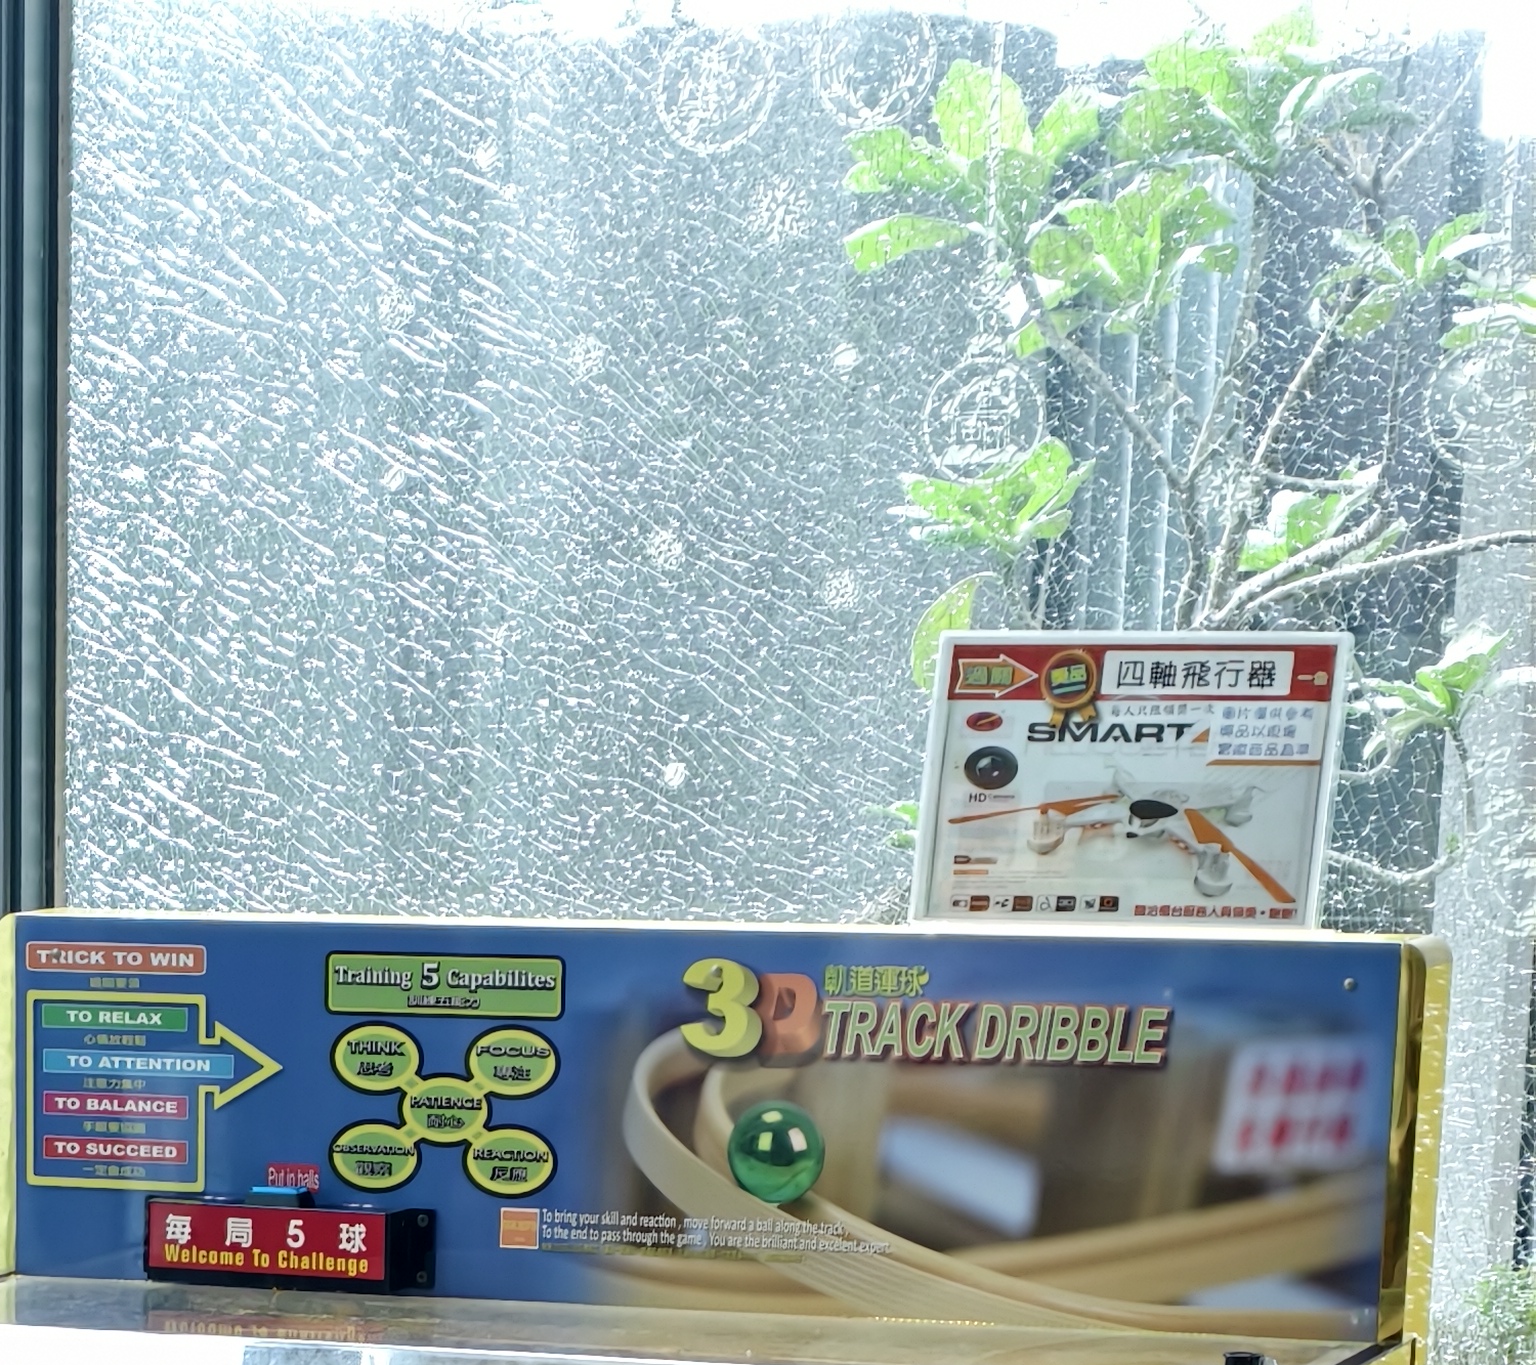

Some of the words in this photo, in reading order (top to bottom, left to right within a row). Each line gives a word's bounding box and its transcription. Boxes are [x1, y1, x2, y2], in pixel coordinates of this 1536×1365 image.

[1116, 660, 1276, 689] 四軸飛行器
[1027, 722, 1197, 744] SMART
[969, 793, 987, 803] HD
[37, 949, 106, 966] TRICK
[112, 951, 143, 966] TO
[150, 951, 195, 968] WIN
[335, 965, 412, 990] Training
[421, 962, 440, 988] 5
[447, 968, 556, 993] Capabilites
[66, 1010, 92, 1023] TO
[98, 1011, 163, 1025] RELAX
[680, 957, 819, 1062] 3D
[823, 1000, 970, 1060] TRACK
[975, 1004, 1170, 1065] DRIBBLE
[348, 1040, 406, 1055] THINK
[476, 1046, 551, 1057] FOCUS
[67, 1055, 92, 1067] TO
[98, 1057, 210, 1071] ATTENTION
[54, 1097, 81, 1110] TO
[86, 1098, 178, 1113] BALANCE
[411, 1096, 482, 1109] PATIENCE
[54, 1141, 81, 1154] TO
[86, 1142, 177, 1158] SUCCEED
[333, 1144, 415, 1155] OBSERVATION
[473, 1148, 549, 1162] REACTION
[268, 1167, 284, 1186] Put
[286, 1168, 296, 1186] in
[542, 1208, 553, 1223] To
[554, 1209, 577, 1227] bring
[579, 1213, 599, 1227] your
[601, 1211, 619, 1226] skill
[620, 1212, 638, 1227] and
[683, 1218, 708, 1231] move
[710, 1216, 746, 1232] forward
[748, 1220, 755, 1232] a
[775, 1219, 800, 1237] along
[802, 1219, 818, 1235] the
[542, 1224, 552, 1239] To
[553, 1225, 569, 1240] the
[571, 1226, 587, 1241] end
[589, 1228, 599, 1242] to
[600, 1230, 621, 1245] pass
[622, 1228, 657, 1247] through
[659, 1229, 675, 1245] the
[709, 1233, 726, 1247] You
[727, 1236, 742, 1248] are
[744, 1233, 760, 1249] the
[761, 1234, 798, 1250] brilliant
[799, 1237, 817, 1251] and
[165, 1244, 244, 1266] Welcome
[252, 1249, 270, 1268] To
[278, 1250, 369, 1277] Challenge
